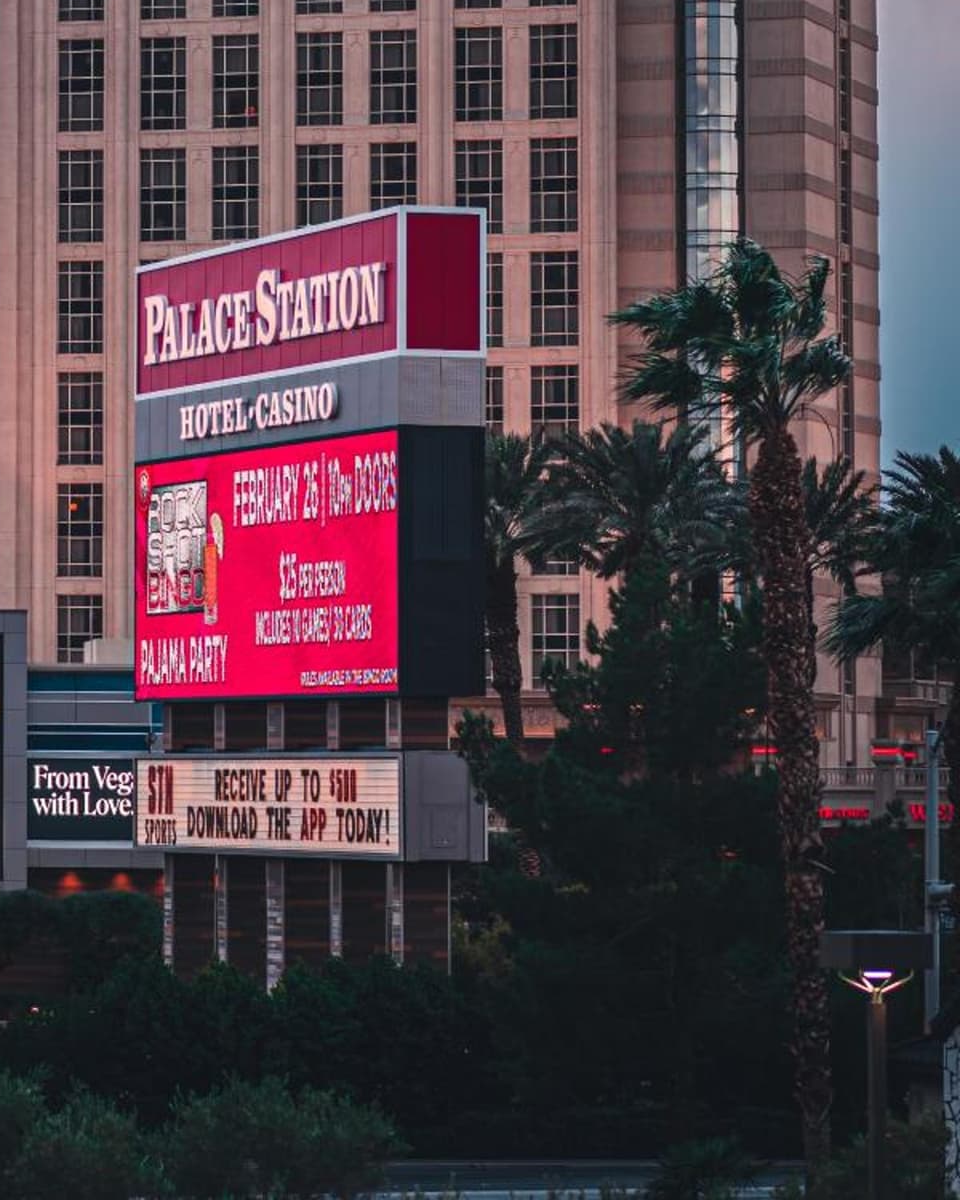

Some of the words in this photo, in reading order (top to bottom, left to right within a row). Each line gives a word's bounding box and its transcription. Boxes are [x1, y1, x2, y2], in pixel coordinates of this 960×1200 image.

[143, 291, 252, 366] PALACE
[255, 262, 386, 347] STATION
[180, 398, 249, 440] HOTEL
[255, 383, 338, 429] CASINO
[233, 463, 300, 527] FEBRUARY
[303, 460, 319, 520] 26
[354, 450, 398, 514] DOORS
[147, 569, 205, 610] BINGO
[279, 551, 297, 604] $25
[315, 560, 346, 596] PERSON
[140, 636, 187, 685] PAJAMA
[189, 633, 228, 683] PARTY
[33, 764, 90, 789] From
[147, 765, 174, 815] STN
[214, 769, 267, 802] RECEIVE
[275, 769, 291, 802] UP
[301, 769, 320, 802] TO
[329, 769, 357, 803] $500
[33, 792, 79, 816] with
[187, 805, 258, 840] DOWNLOAD
[267, 806, 291, 841] THE
[300, 808, 327, 841] APP
[336, 808, 390, 846] TODAY!
[145, 818, 177, 845] SPORTS
